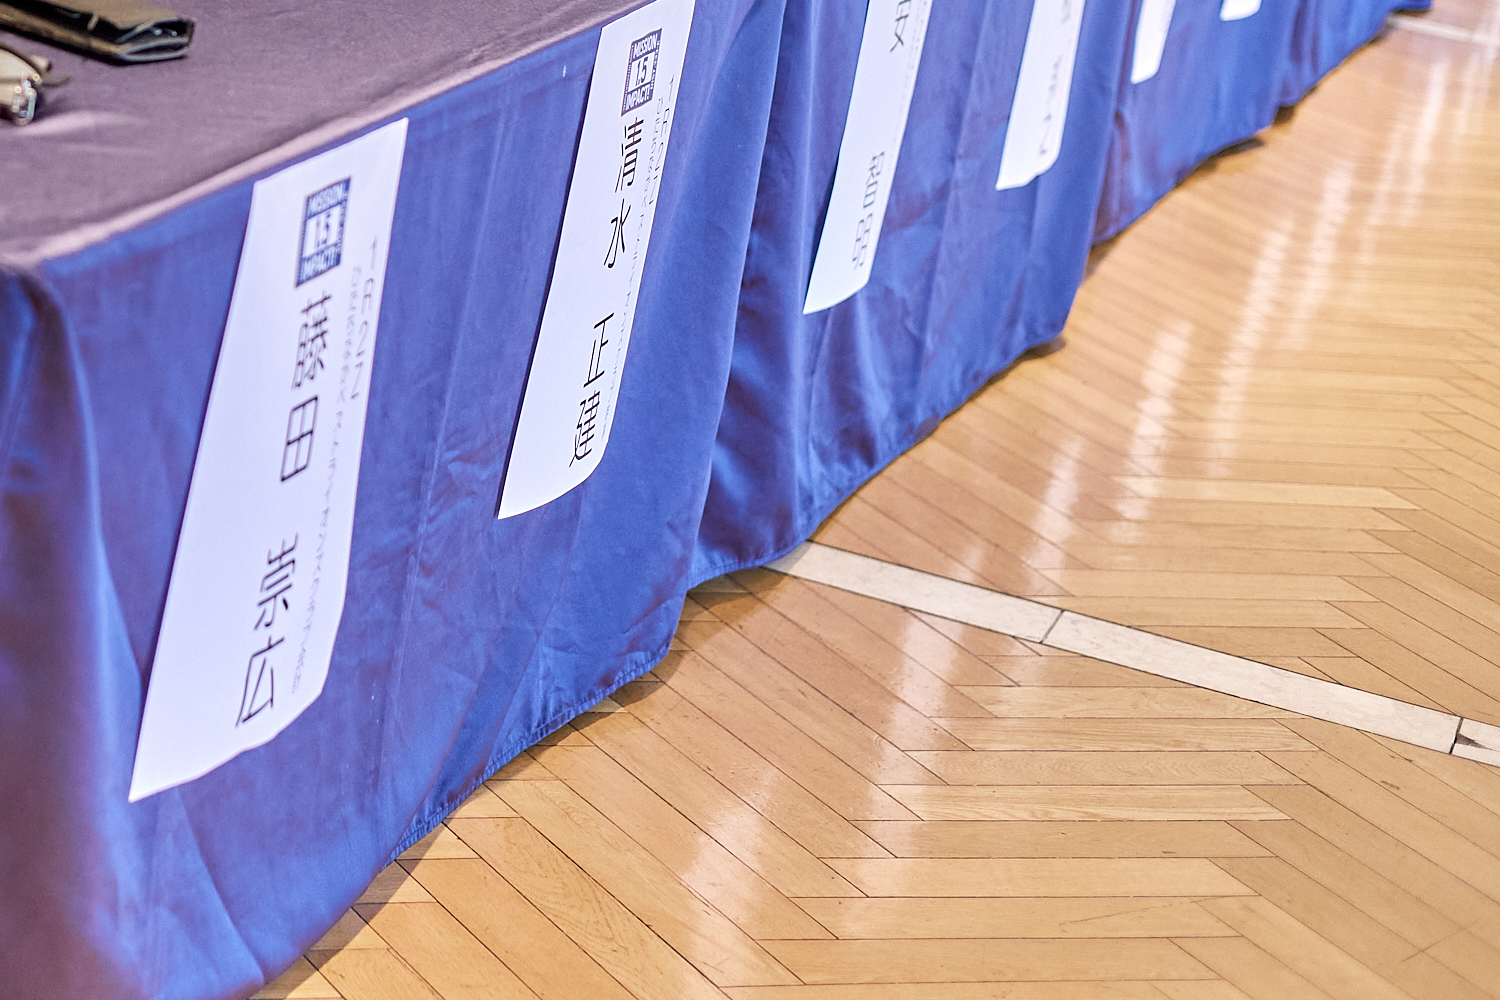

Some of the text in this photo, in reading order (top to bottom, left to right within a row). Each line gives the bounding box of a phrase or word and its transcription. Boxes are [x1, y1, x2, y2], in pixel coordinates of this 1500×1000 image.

[632, 34, 658, 59] MISSION
[635, 57, 649, 87] 1.5
[625, 84, 650, 111] IMPACT!
[568, 117, 644, 469] 清水 正建
[235, 290, 333, 728] 藤田 崇広
